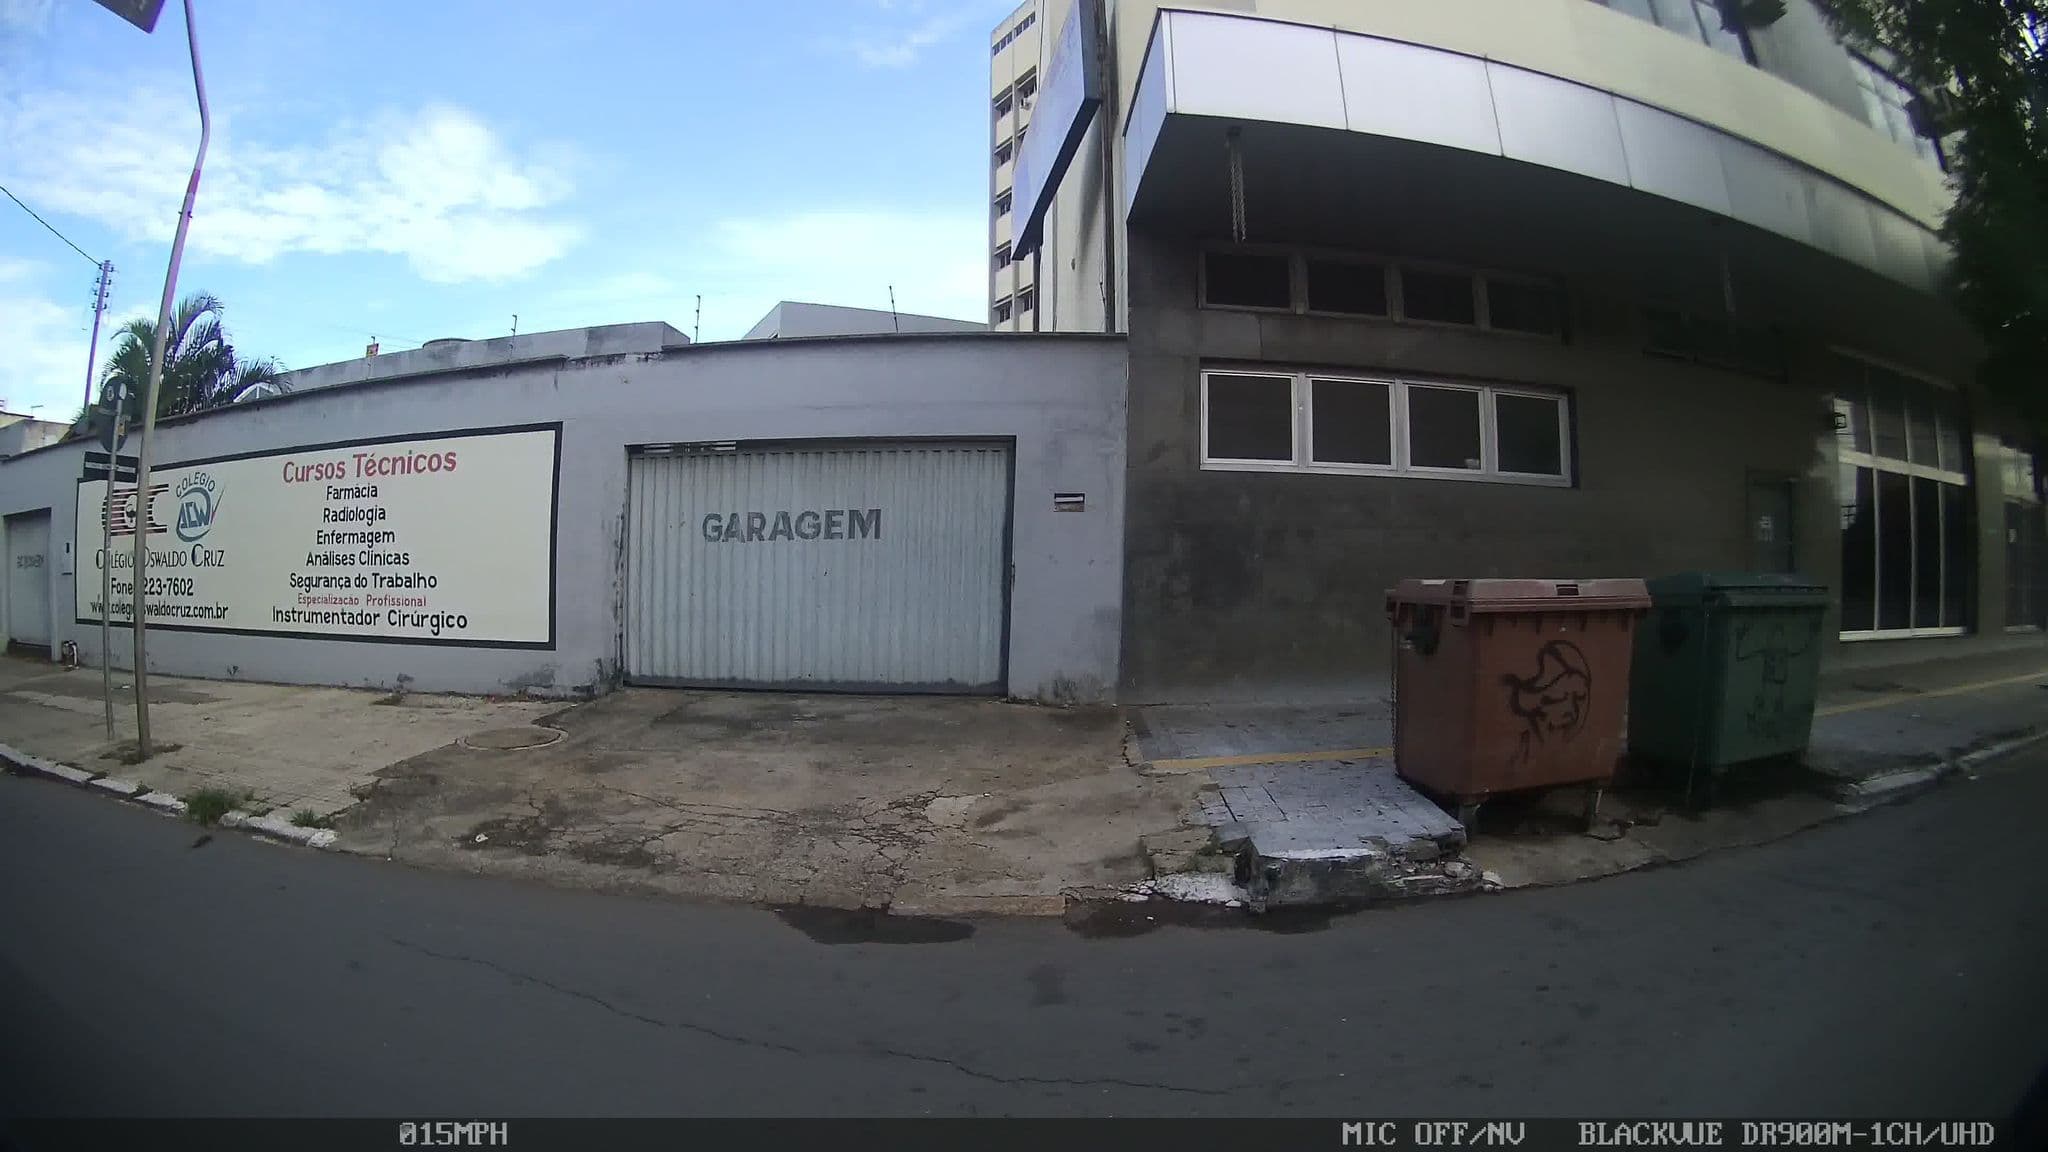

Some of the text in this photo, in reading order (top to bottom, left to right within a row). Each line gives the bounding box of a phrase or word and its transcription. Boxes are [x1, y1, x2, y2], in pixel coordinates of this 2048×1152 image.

[283, 450, 457, 483] Cursos Técnicos
[323, 505, 386, 527] Radiologia
[702, 508, 882, 543] GARAGEM
[316, 530, 395, 548] Enfermagem
[96, 549, 135, 569] CLÉGIO
[191, 543, 225, 567] CRUZ
[306, 551, 355, 567] Análises
[290, 572, 437, 592] Segurança do Trabalho
[366, 594, 427, 607] Profissional
[272, 606, 468, 635] Instrumentador Cirúrgico
